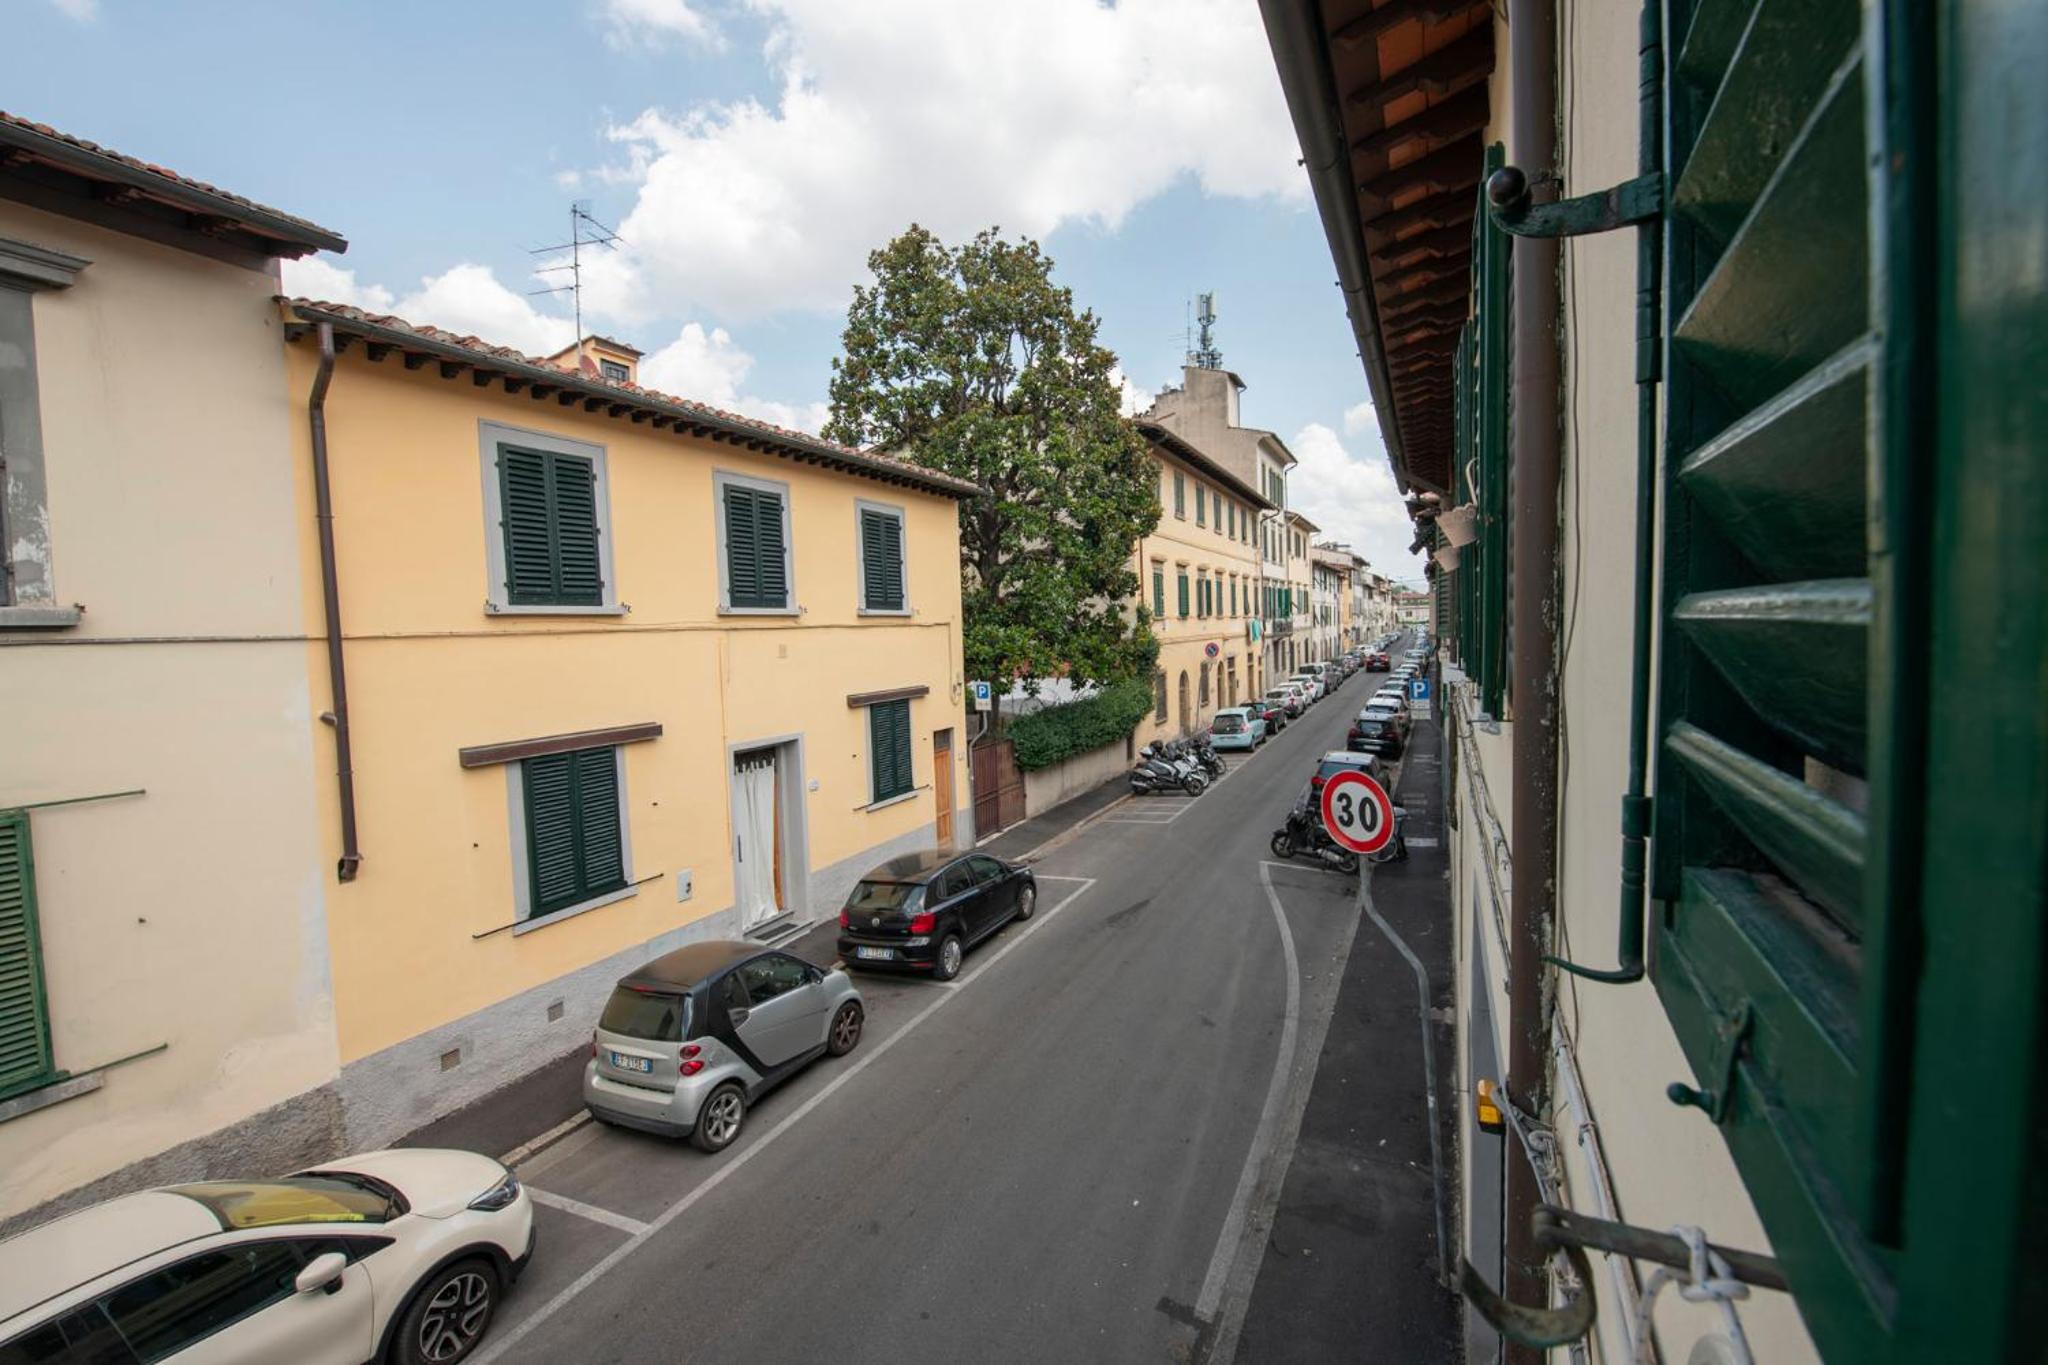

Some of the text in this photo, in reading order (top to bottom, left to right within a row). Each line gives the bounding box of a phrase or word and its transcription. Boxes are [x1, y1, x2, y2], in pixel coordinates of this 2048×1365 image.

[979, 686, 987, 697] P
[1413, 682, 1425, 697] P
[1337, 792, 1378, 833] 30
